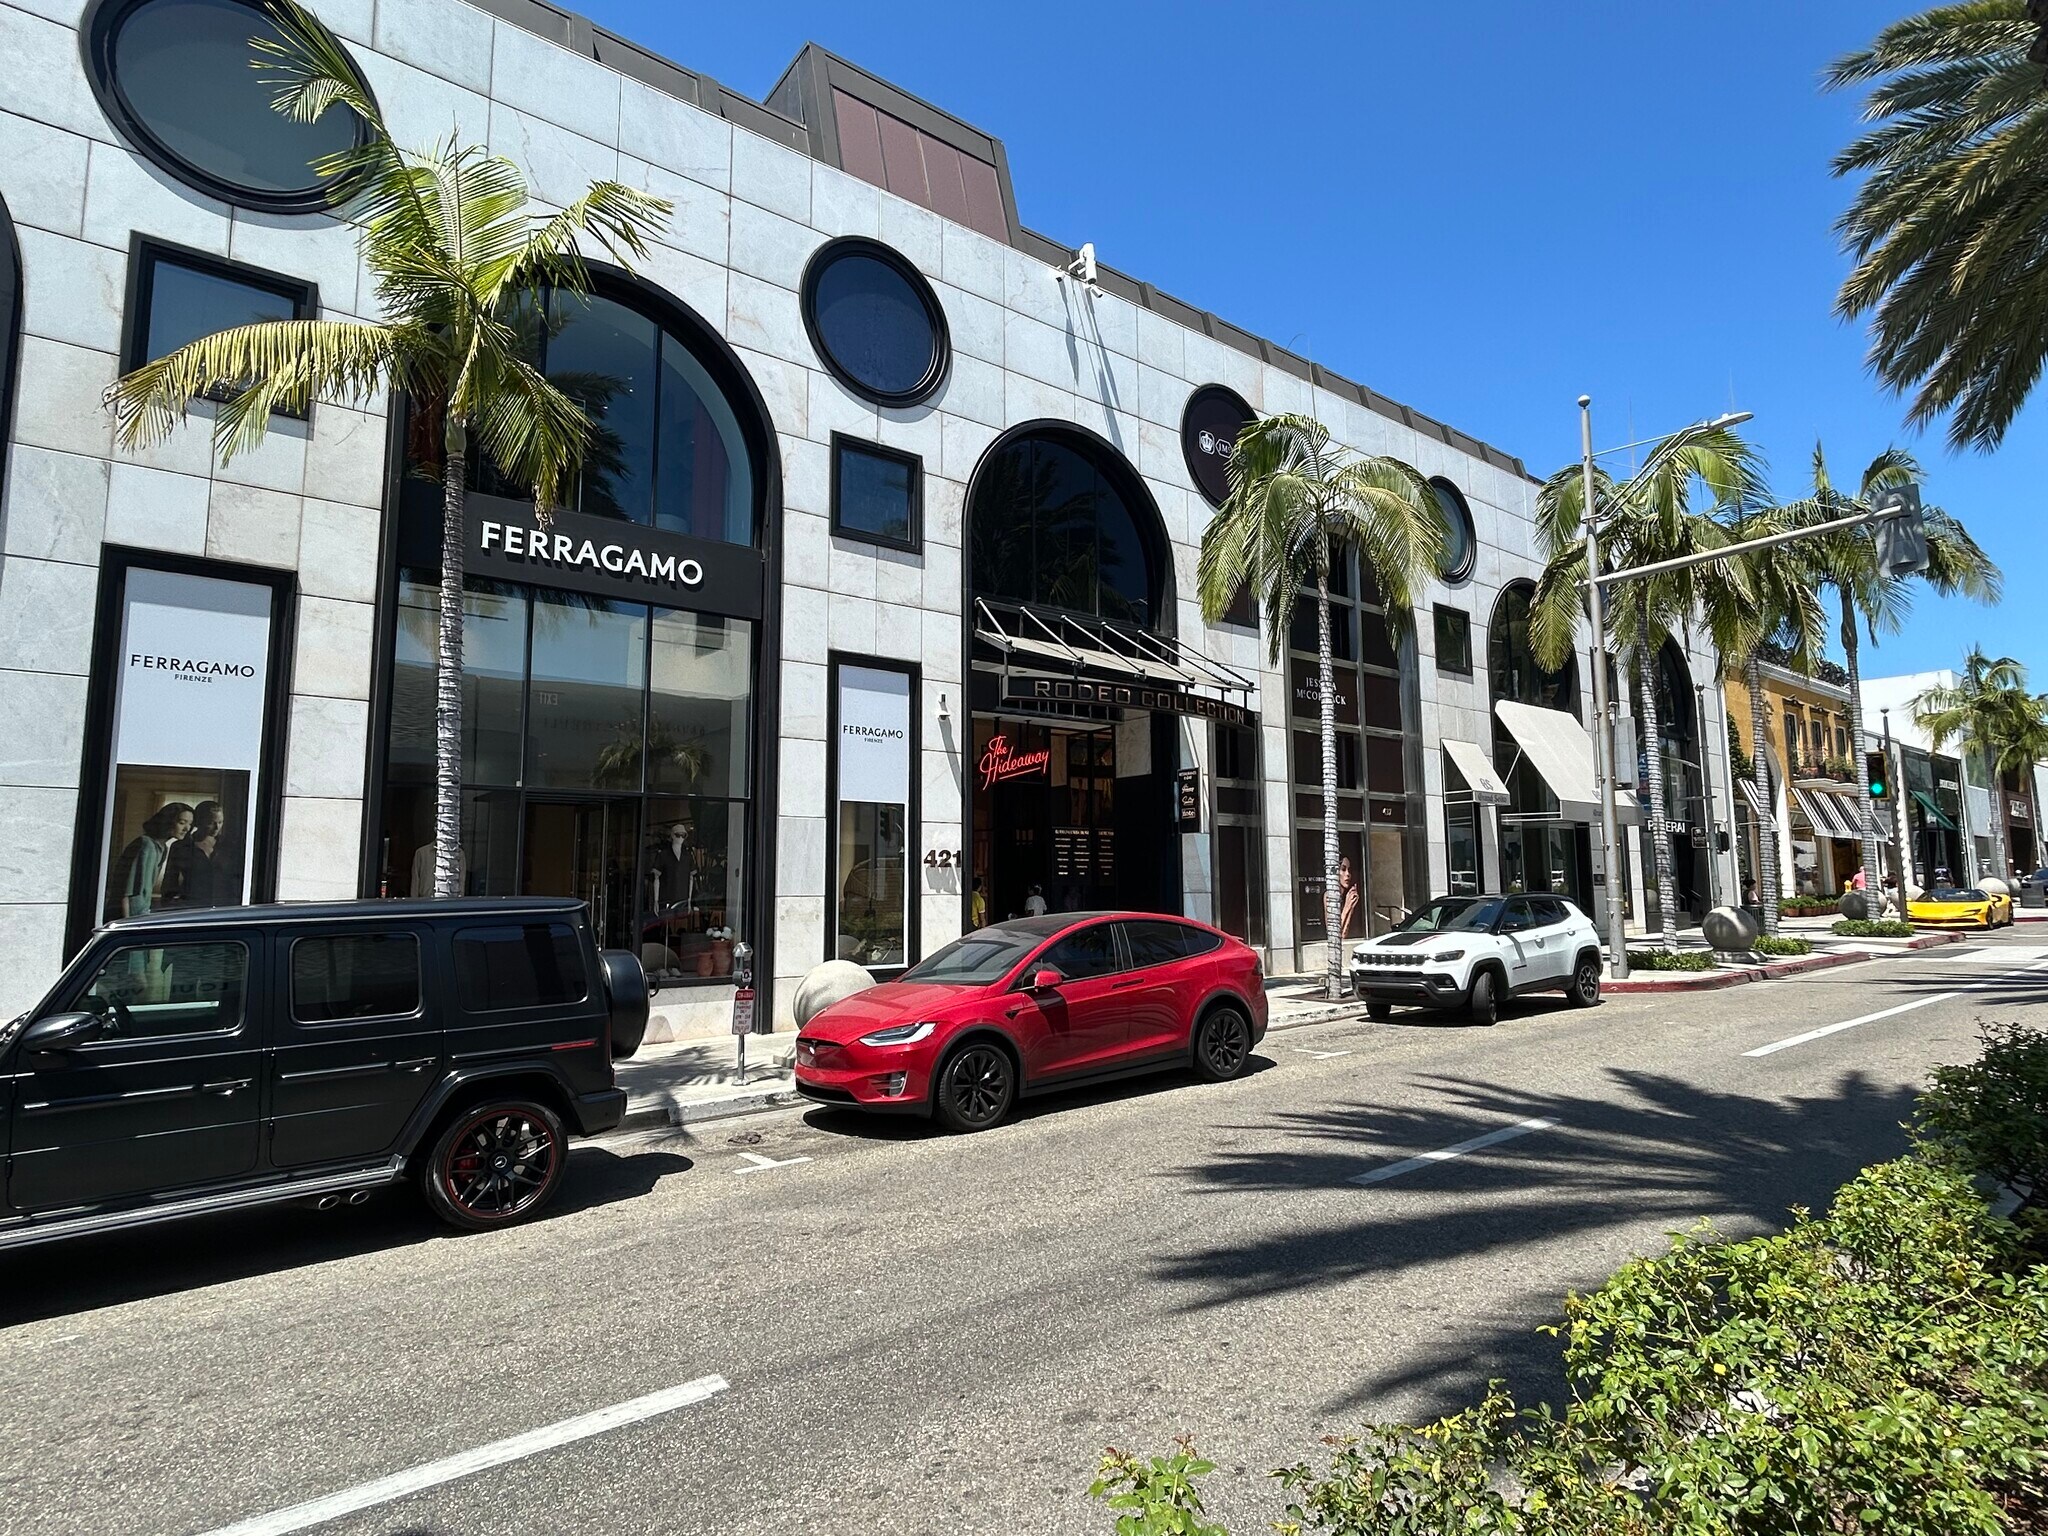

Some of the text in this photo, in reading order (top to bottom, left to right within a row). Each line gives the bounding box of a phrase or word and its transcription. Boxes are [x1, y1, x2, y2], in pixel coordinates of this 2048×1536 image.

[480, 520, 703, 585] FERRAGAMO
[130, 654, 255, 678] FERRAGAMO
[174, 673, 213, 683] FIRENZE
[1034, 680, 1245, 725] RODEO COLLECTION
[842, 725, 904, 739] FERRAGAMO
[988, 735, 1008, 758] The
[979, 745, 1049, 791] Hideaway
[1647, 819, 1686, 833] PERAI
[923, 849, 962, 868] 421
